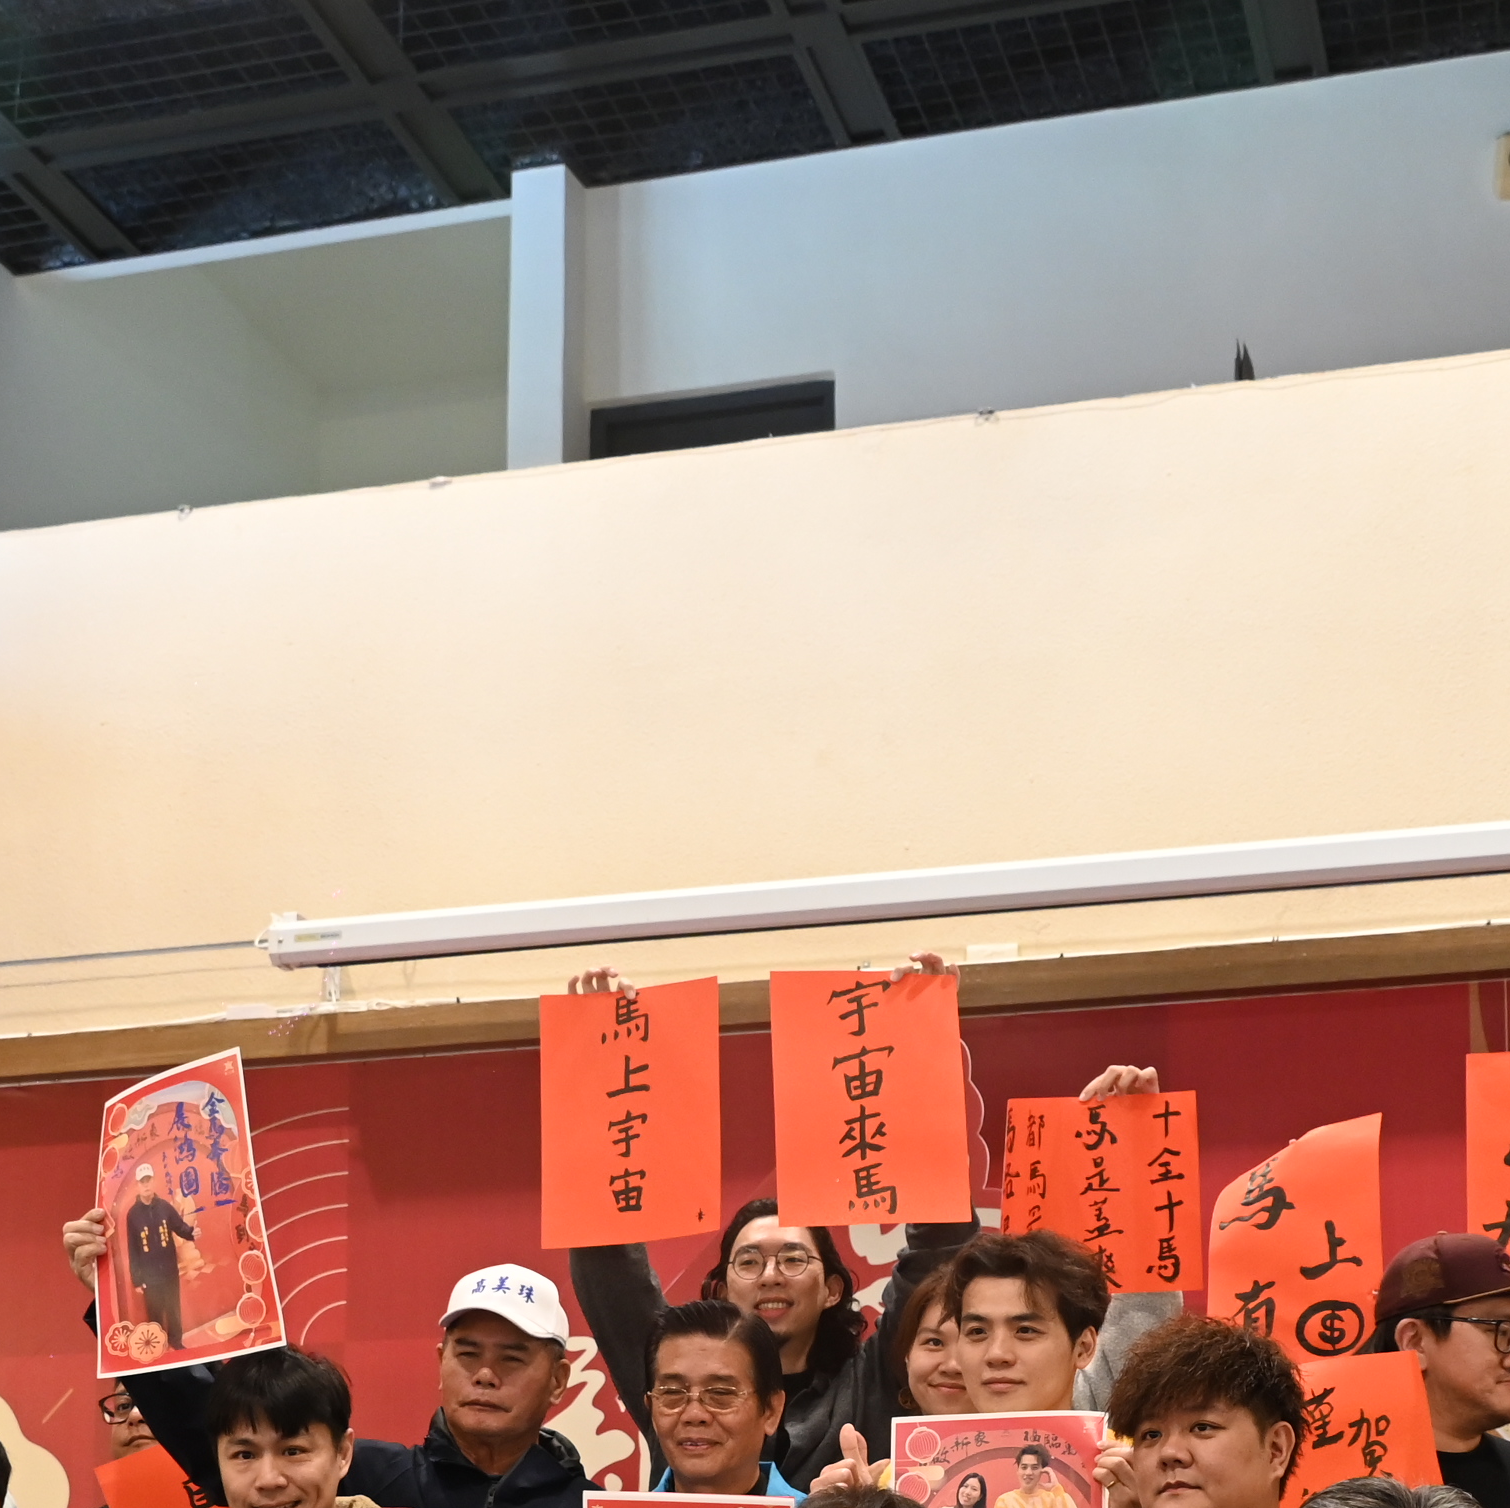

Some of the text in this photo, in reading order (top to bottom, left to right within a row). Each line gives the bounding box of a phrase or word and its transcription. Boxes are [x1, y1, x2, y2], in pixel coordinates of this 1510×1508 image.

[601, 991, 651, 1213] 馬上宇宙
[827, 979, 898, 1215] 宇宙來馬
[1146, 1100, 1185, 1284] 十全十馬
[471, 1276, 535, 1303] 高美珠
